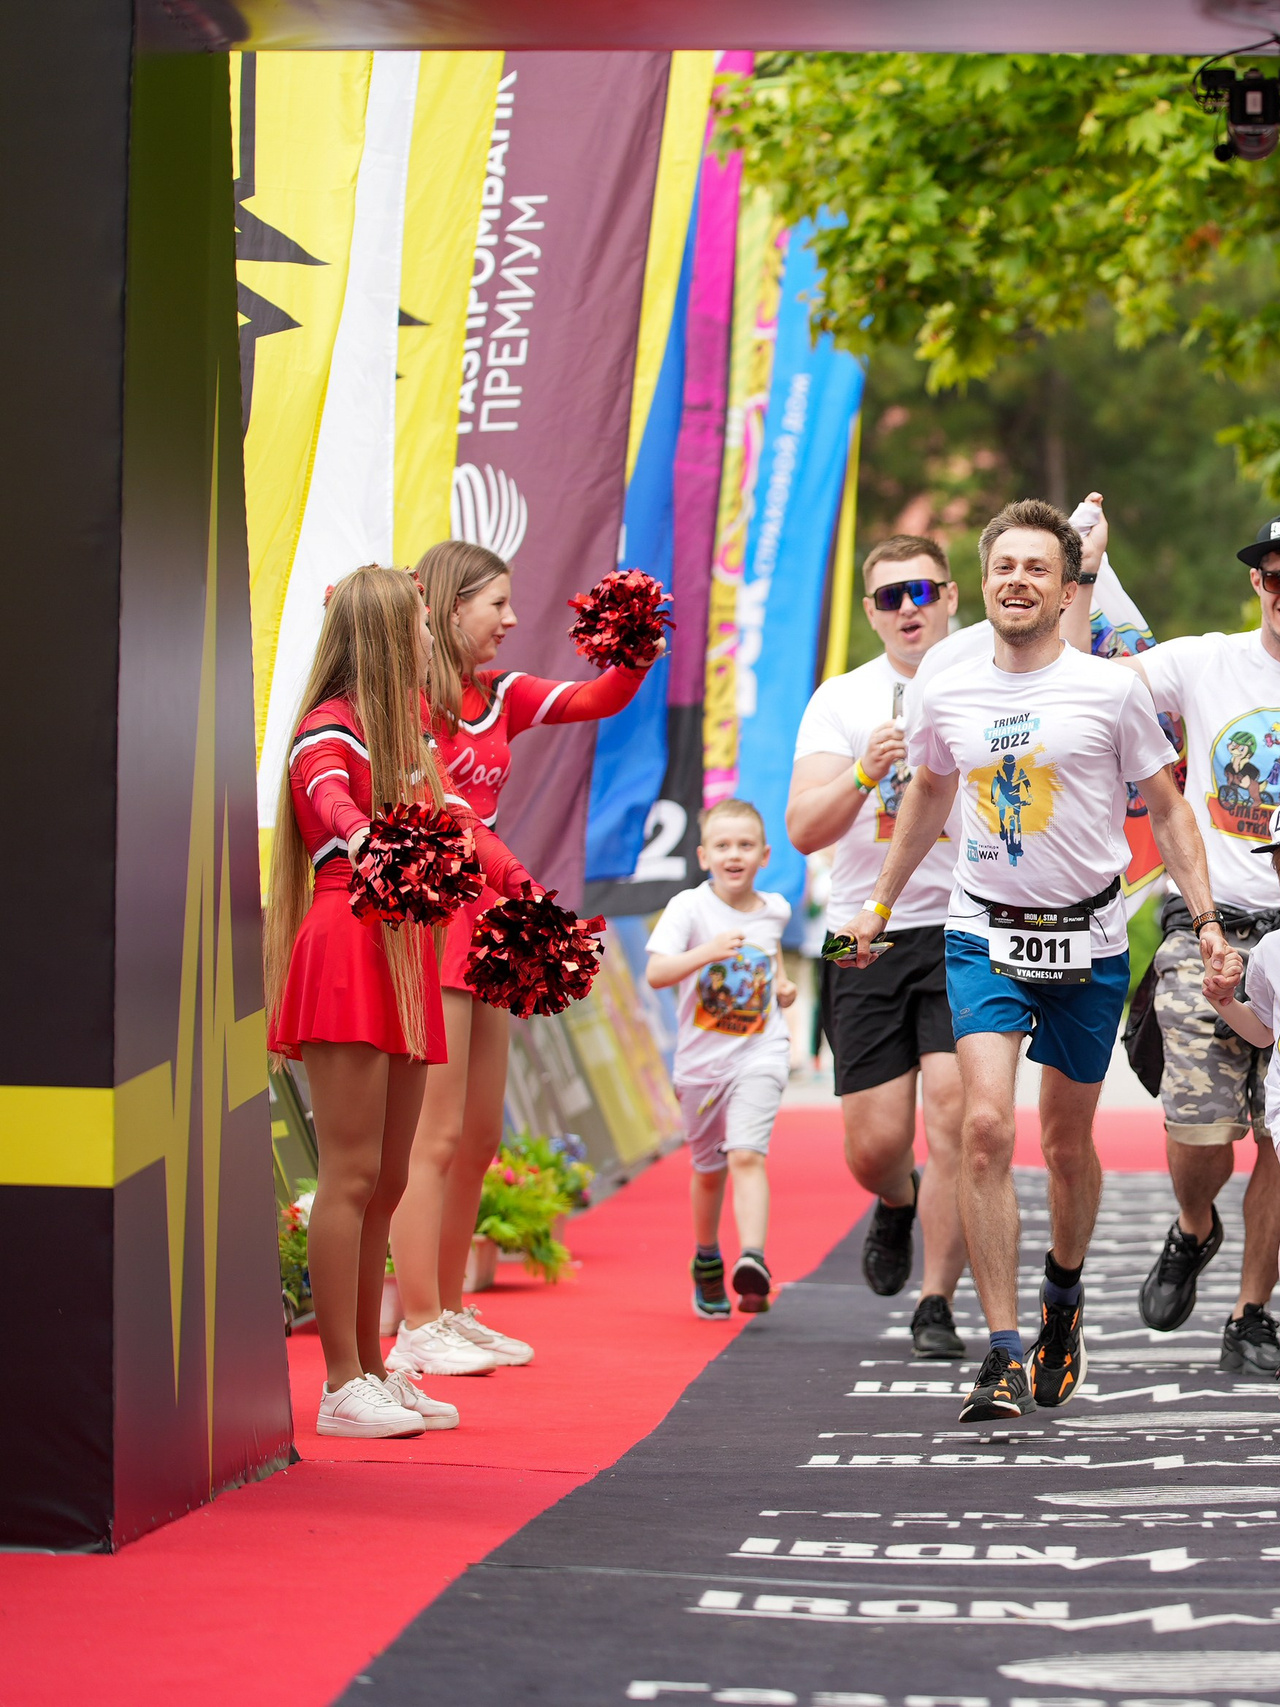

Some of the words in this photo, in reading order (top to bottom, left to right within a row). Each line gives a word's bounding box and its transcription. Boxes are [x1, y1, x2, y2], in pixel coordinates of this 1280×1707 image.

[479, 195, 548, 432] ПРЕМИУМ
[994, 712, 1030, 728] TRIWAY
[988, 722, 1035, 737] TRIATHLON
[990, 731, 1030, 752] 2022
[1024, 913, 1038, 921] IRON
[1009, 935, 1071, 963] 2011
[1016, 968, 1063, 979] VYACHESLAV
[807, 1454, 1092, 1465] IRON
[739, 1537, 1077, 1558] IRON
[698, 1591, 1070, 1619] IRON
